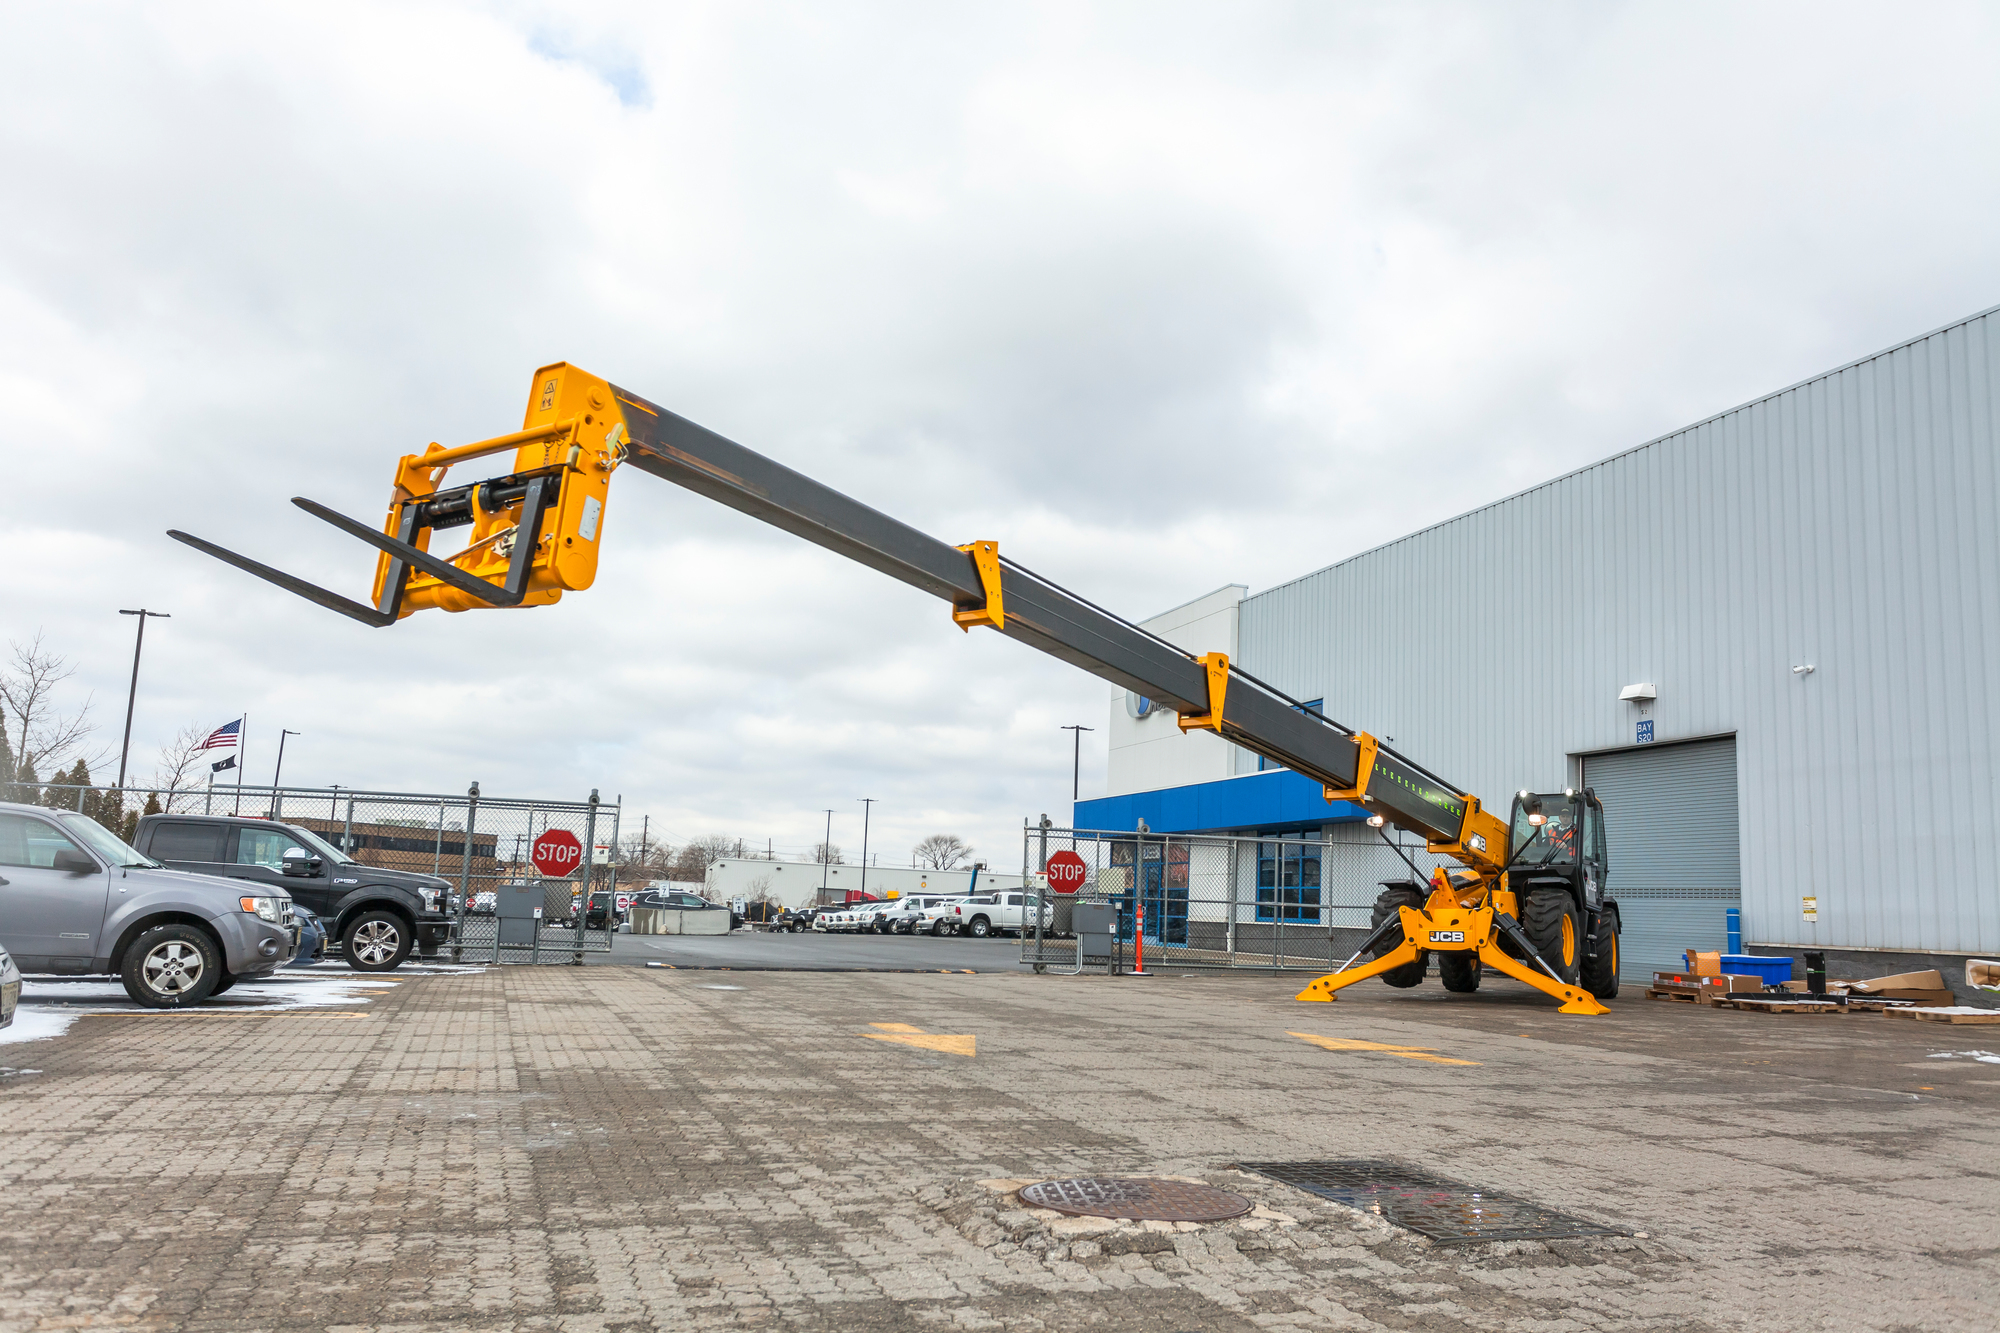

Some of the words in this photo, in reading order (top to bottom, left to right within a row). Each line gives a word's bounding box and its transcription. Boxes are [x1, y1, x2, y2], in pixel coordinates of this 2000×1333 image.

[1637, 722, 1652, 733] BAY
[1638, 733, 1652, 743] S20
[536, 842, 579, 864] STOP
[1049, 863, 1084, 881] STOP
[1430, 931, 1464, 942] JCB
